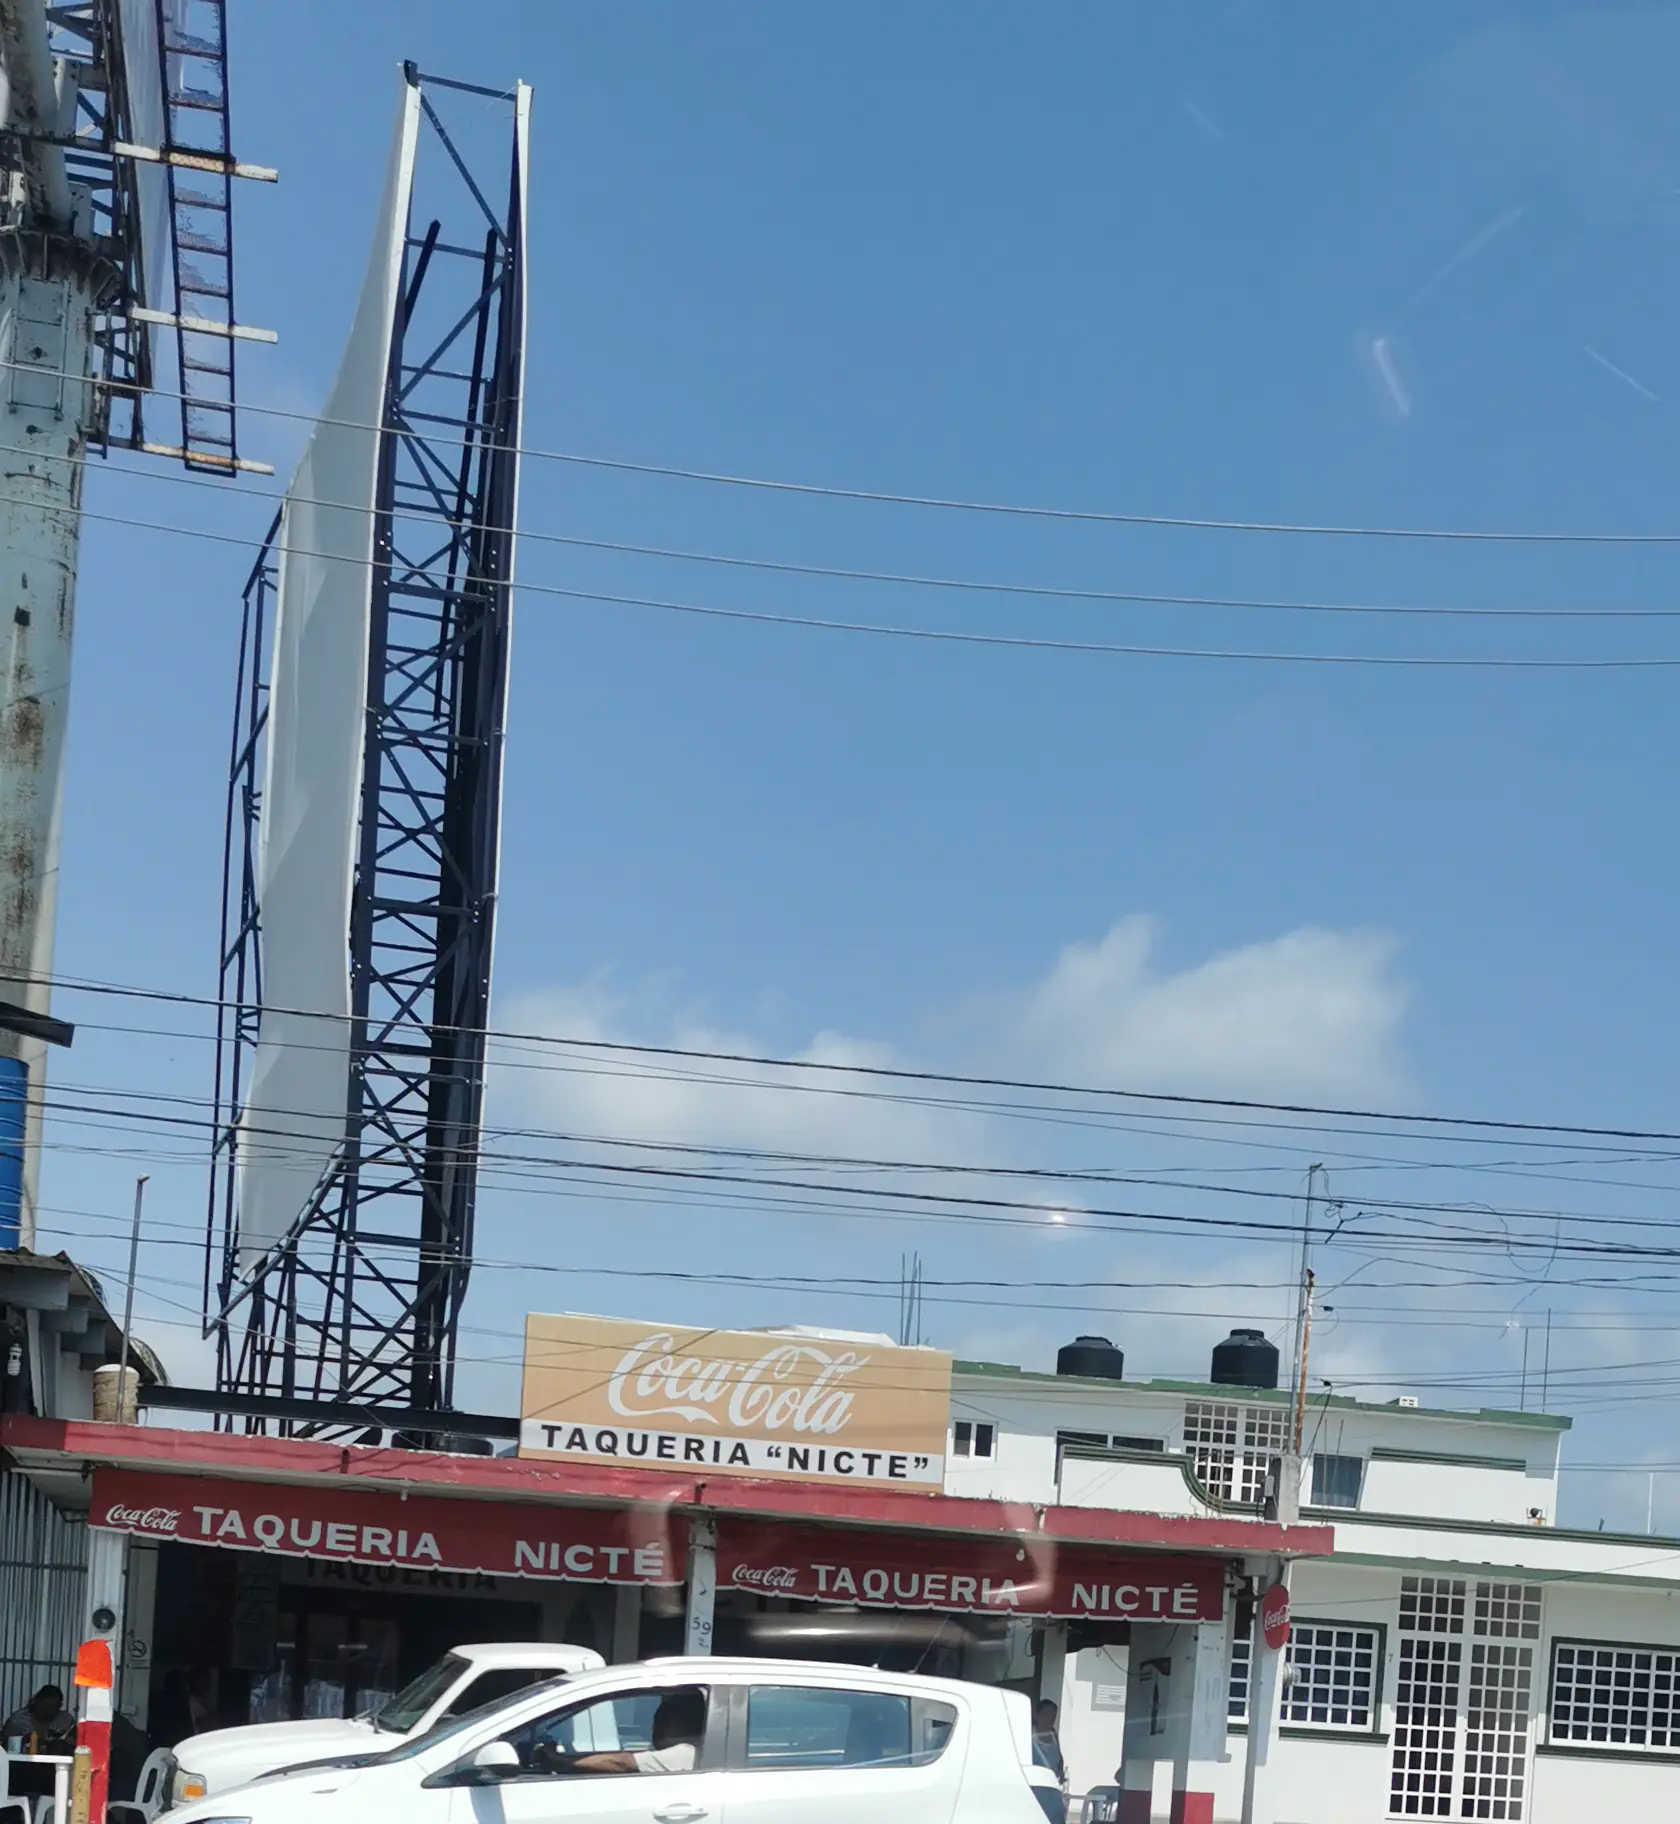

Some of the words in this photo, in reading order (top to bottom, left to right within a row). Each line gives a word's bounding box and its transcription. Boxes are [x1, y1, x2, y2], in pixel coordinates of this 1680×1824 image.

[608, 1333, 872, 1434] Coca-Cola
[541, 1424, 751, 1467] TAQUERIA
[766, 1446, 929, 1479] “NICTE”
[105, 1503, 182, 1532] Coca-Cola
[192, 1506, 443, 1561] TAQUERIA
[514, 1540, 664, 1577] NICTÉ
[732, 1563, 800, 1588] Coca-Cola
[810, 1564, 1020, 1607] TAQUERIA
[1071, 1582, 1199, 1615] NICTÉ
